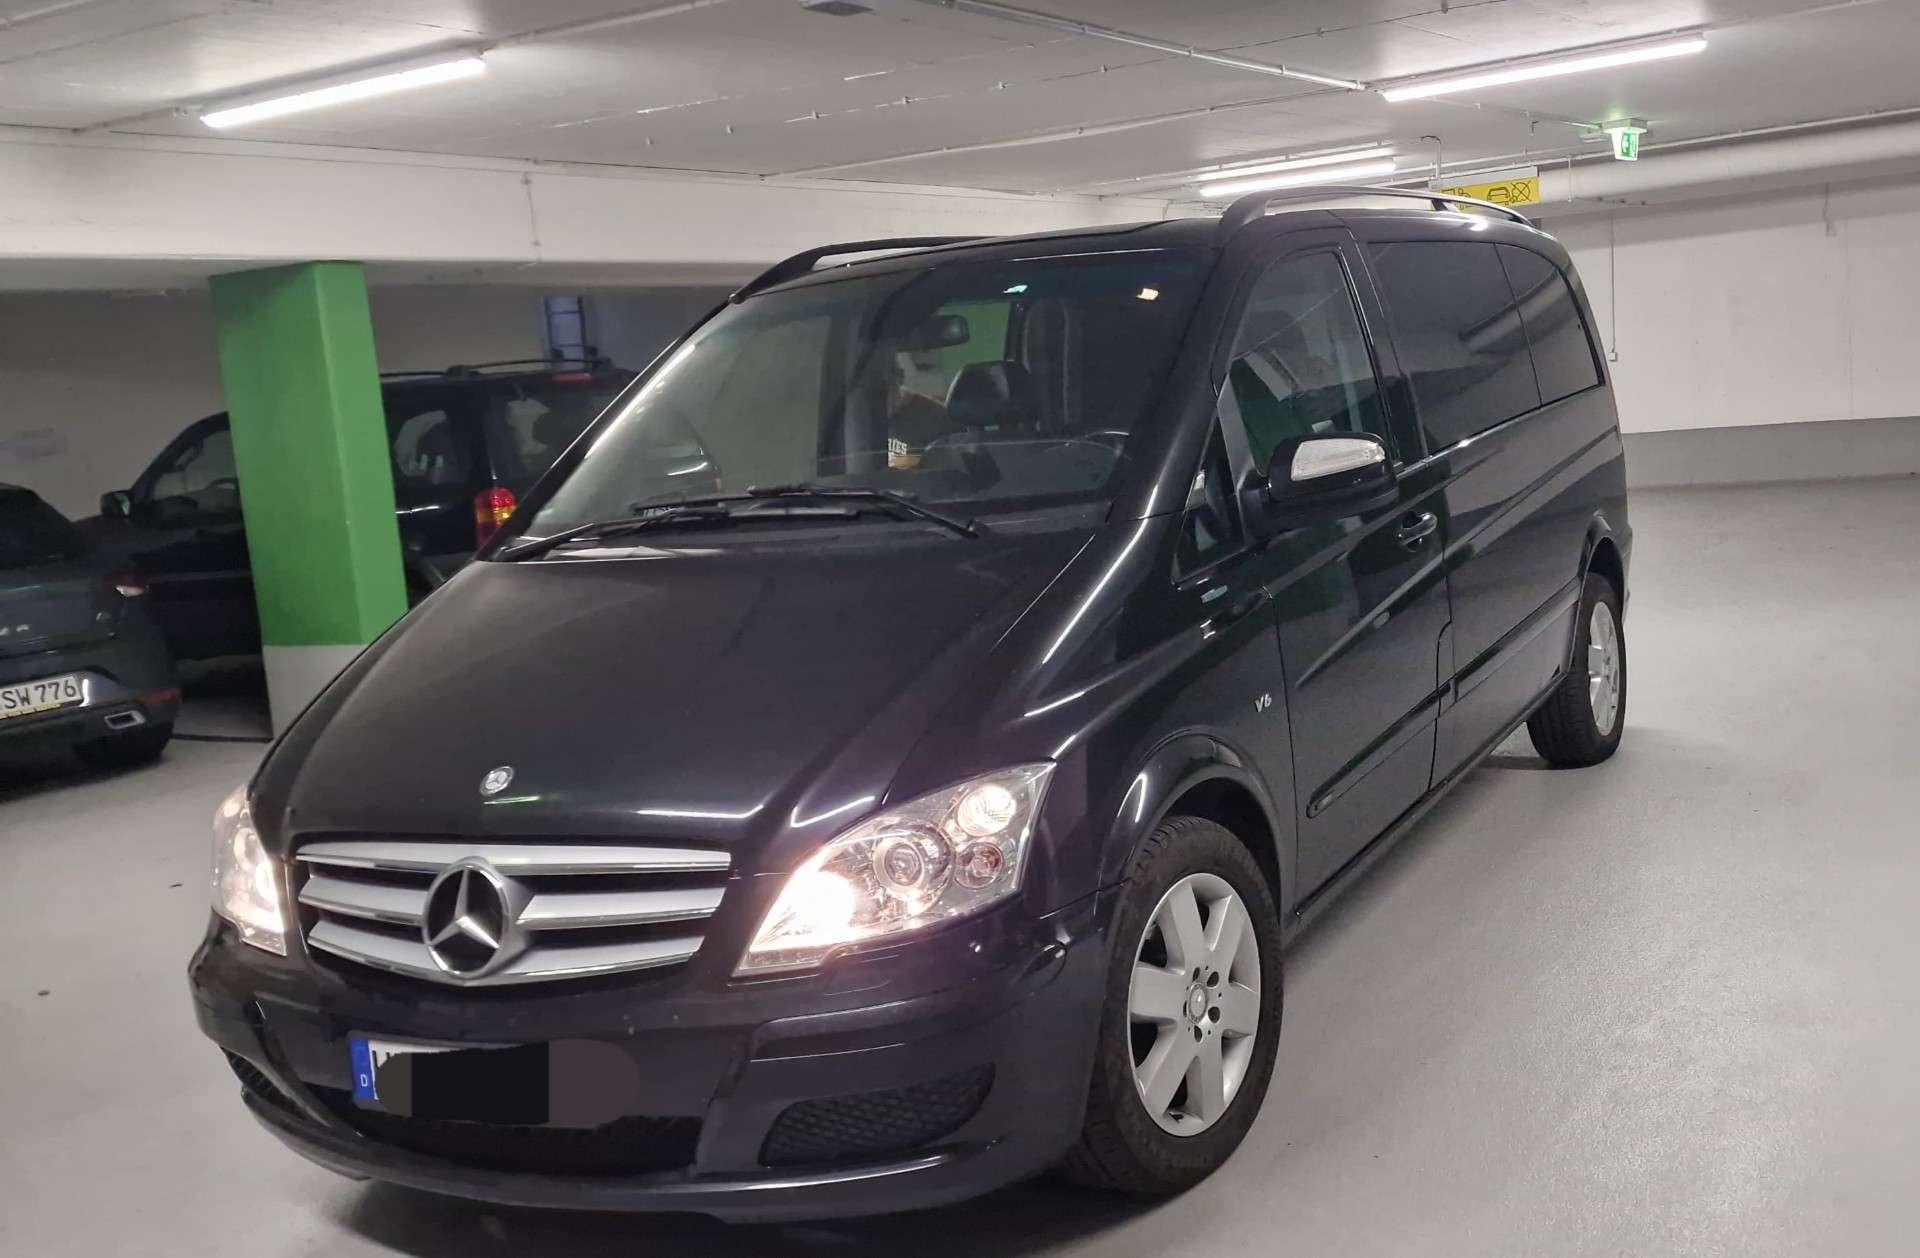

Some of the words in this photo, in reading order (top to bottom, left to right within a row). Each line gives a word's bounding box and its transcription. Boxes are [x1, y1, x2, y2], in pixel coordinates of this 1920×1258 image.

[1, 687, 30, 709] SW
[35, 680, 77, 703] 776
[1254, 693, 1272, 713] V6
[360, 1073, 368, 1087] D
